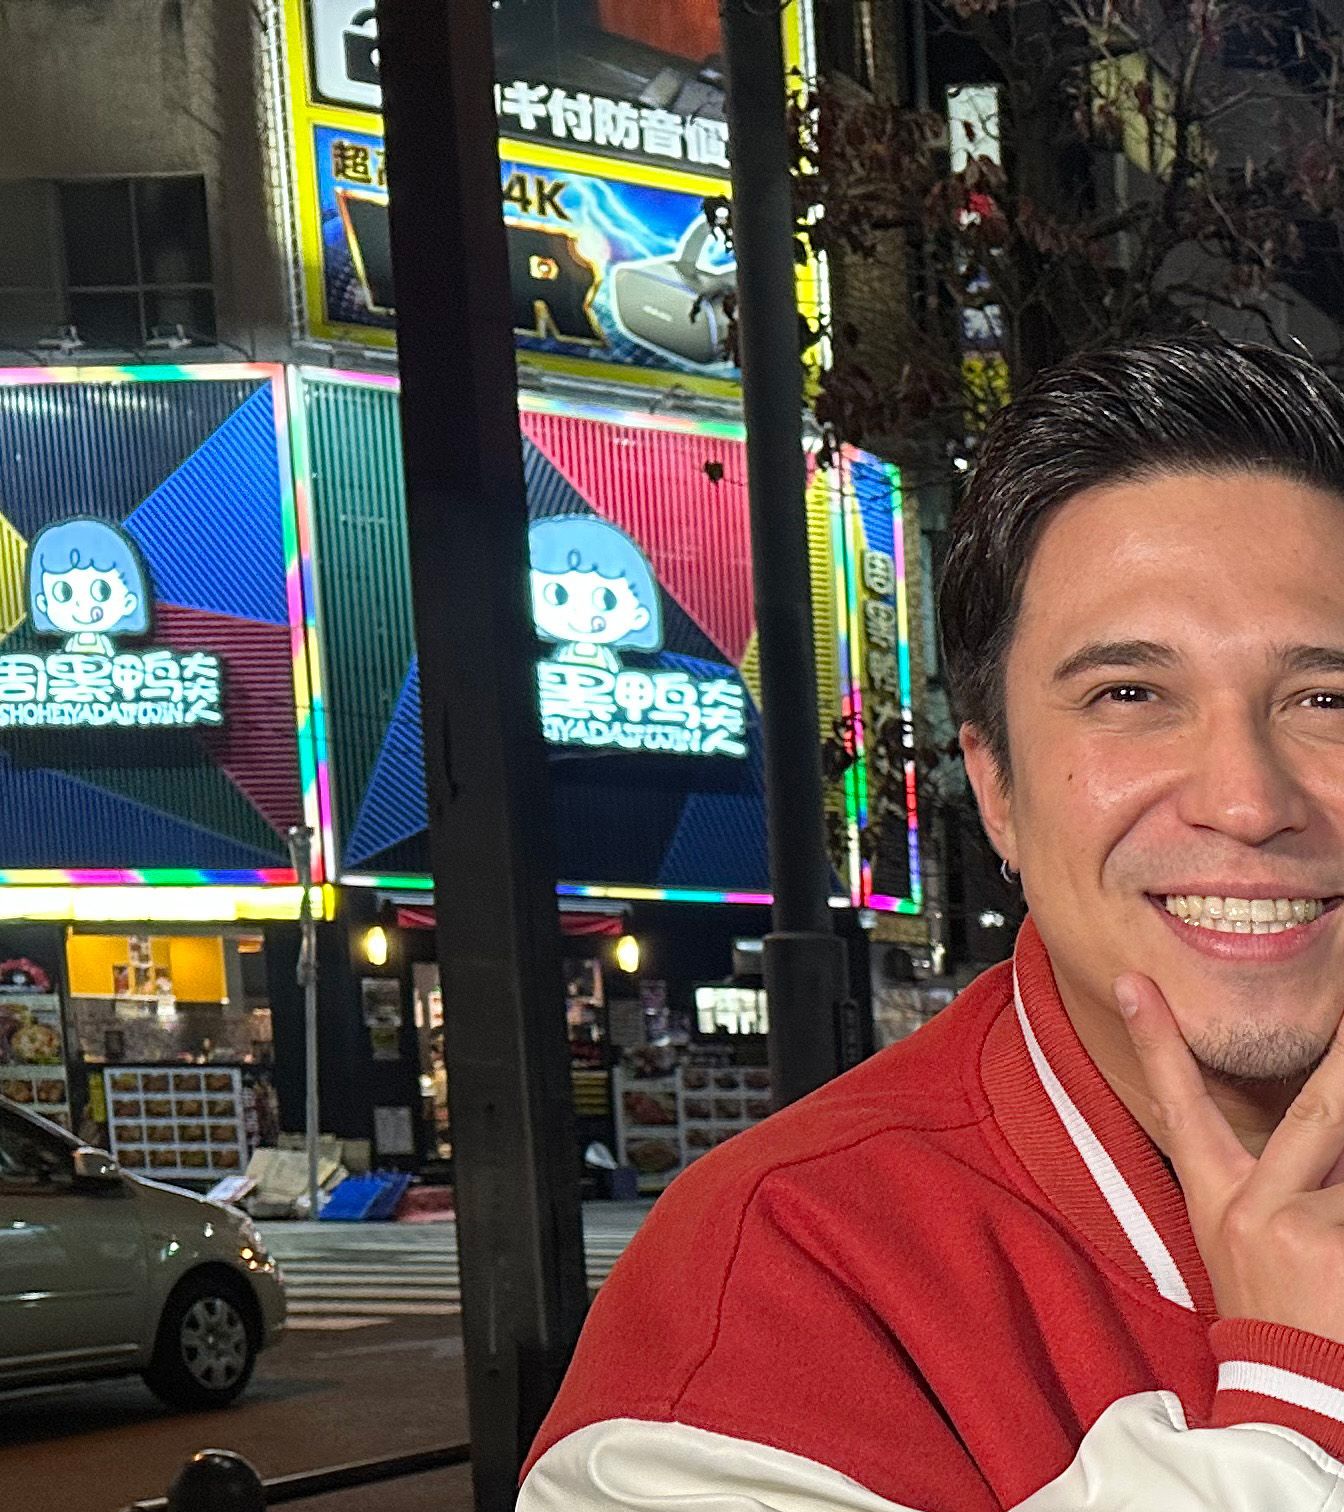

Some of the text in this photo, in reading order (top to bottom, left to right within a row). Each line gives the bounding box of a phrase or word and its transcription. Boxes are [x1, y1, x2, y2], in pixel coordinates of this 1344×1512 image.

[495, 80, 733, 168] ギ付防音個
[331, 139, 388, 188] 超
